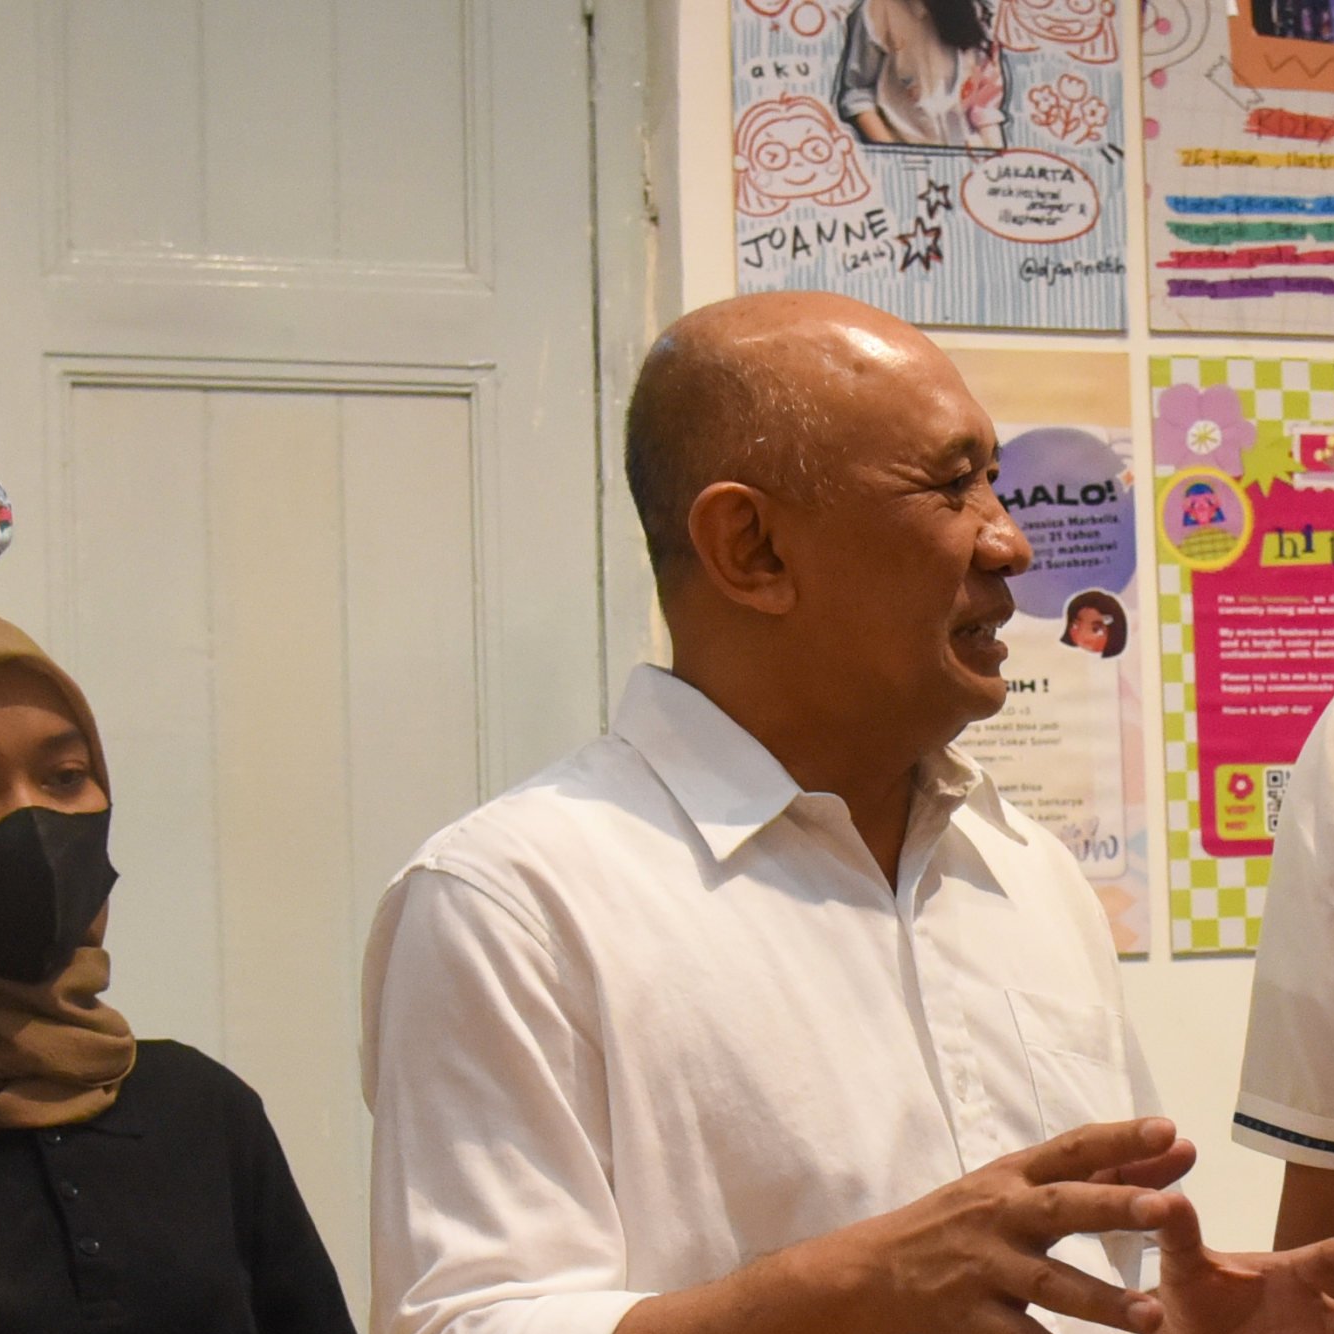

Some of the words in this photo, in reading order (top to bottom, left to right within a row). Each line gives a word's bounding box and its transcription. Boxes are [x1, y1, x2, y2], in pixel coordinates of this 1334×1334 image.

[983, 165, 1075, 183] JAKARTA
[740, 208, 888, 268] JOANNE
[997, 479, 1118, 513] HALO!
[1274, 524, 1315, 560] hi
